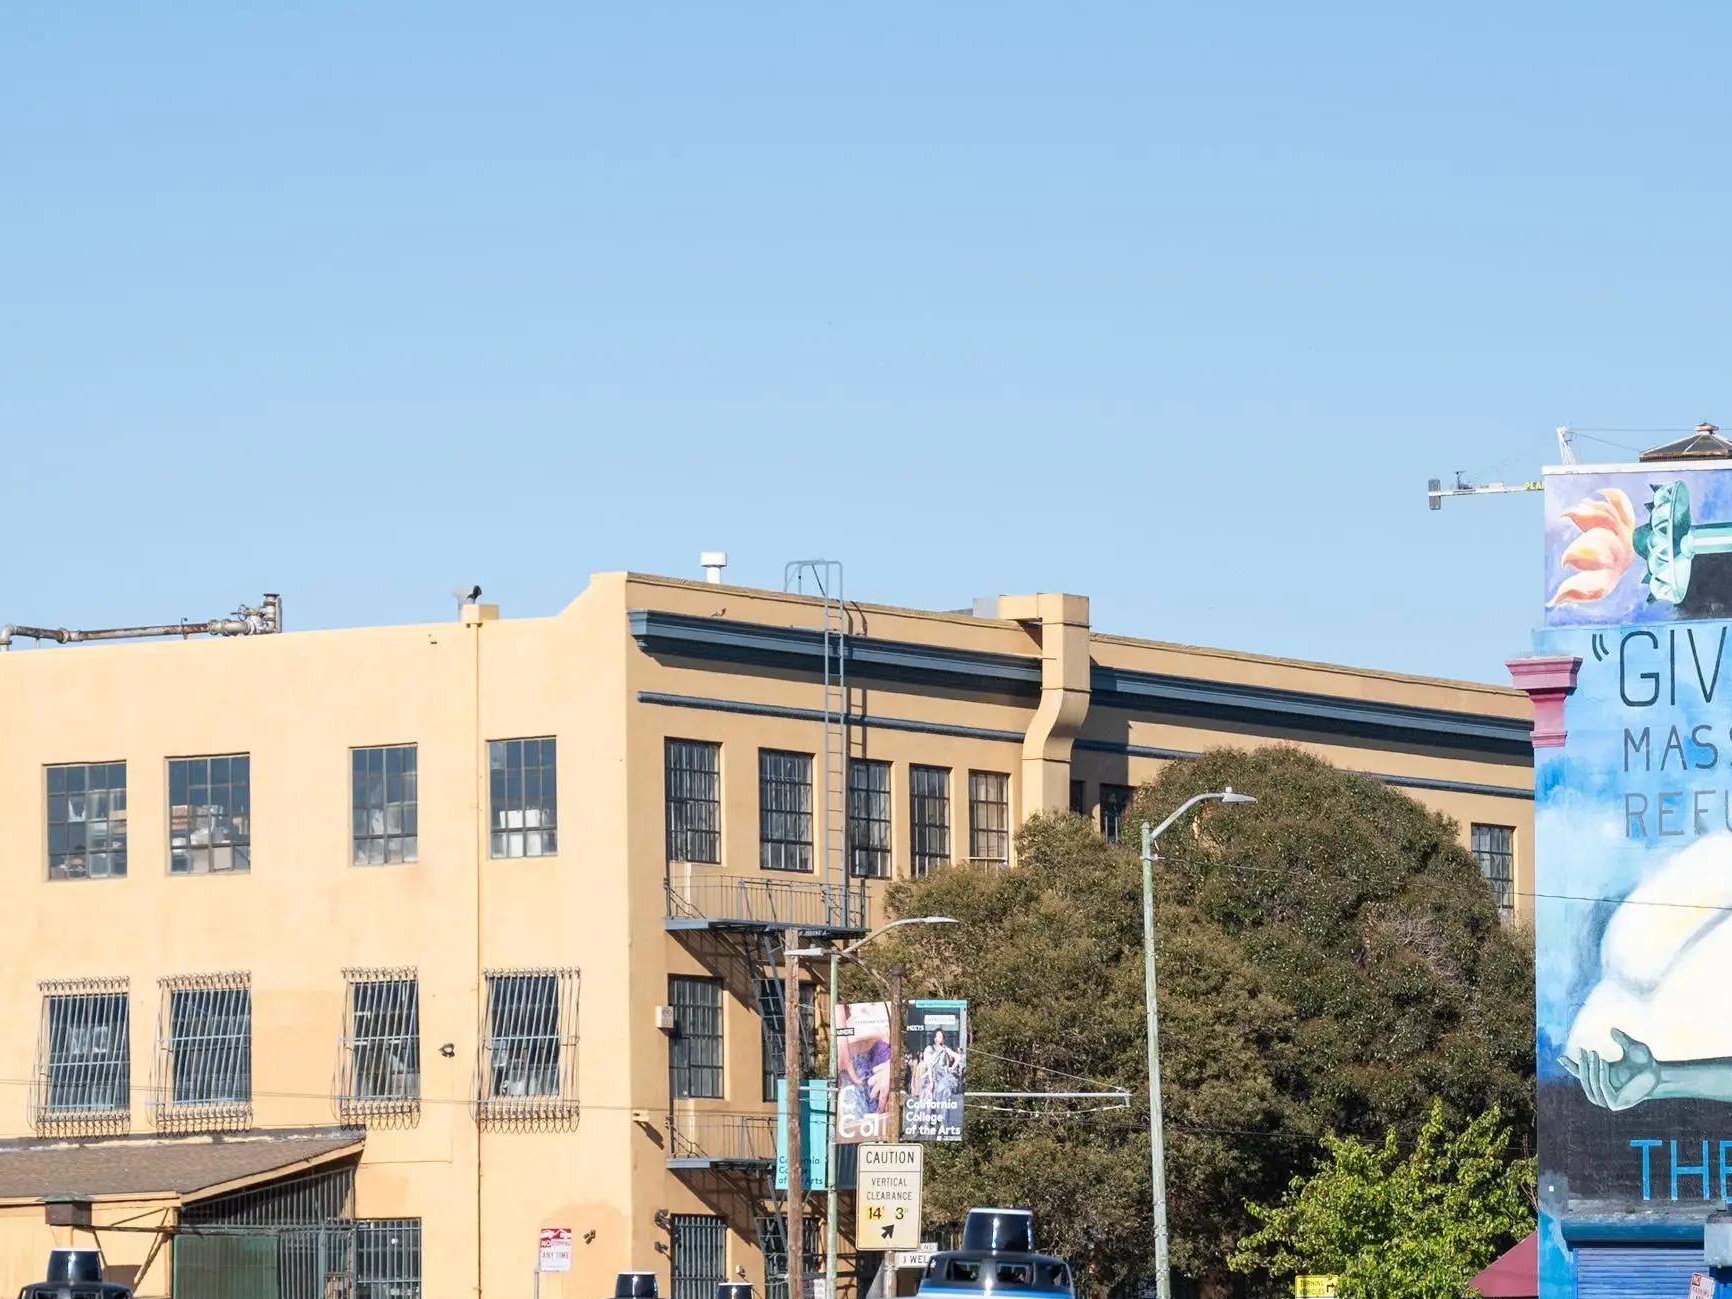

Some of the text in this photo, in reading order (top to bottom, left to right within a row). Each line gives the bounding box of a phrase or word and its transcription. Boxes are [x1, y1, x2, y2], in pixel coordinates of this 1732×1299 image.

[906, 1099, 958, 1110] California
[905, 1112, 943, 1125] College
[905, 1125, 961, 1135] of the Arts
[865, 1151, 915, 1164] CAUTION
[871, 1177, 908, 1187] VERTICAL
[866, 1191, 912, 1201] CLEARANCE
